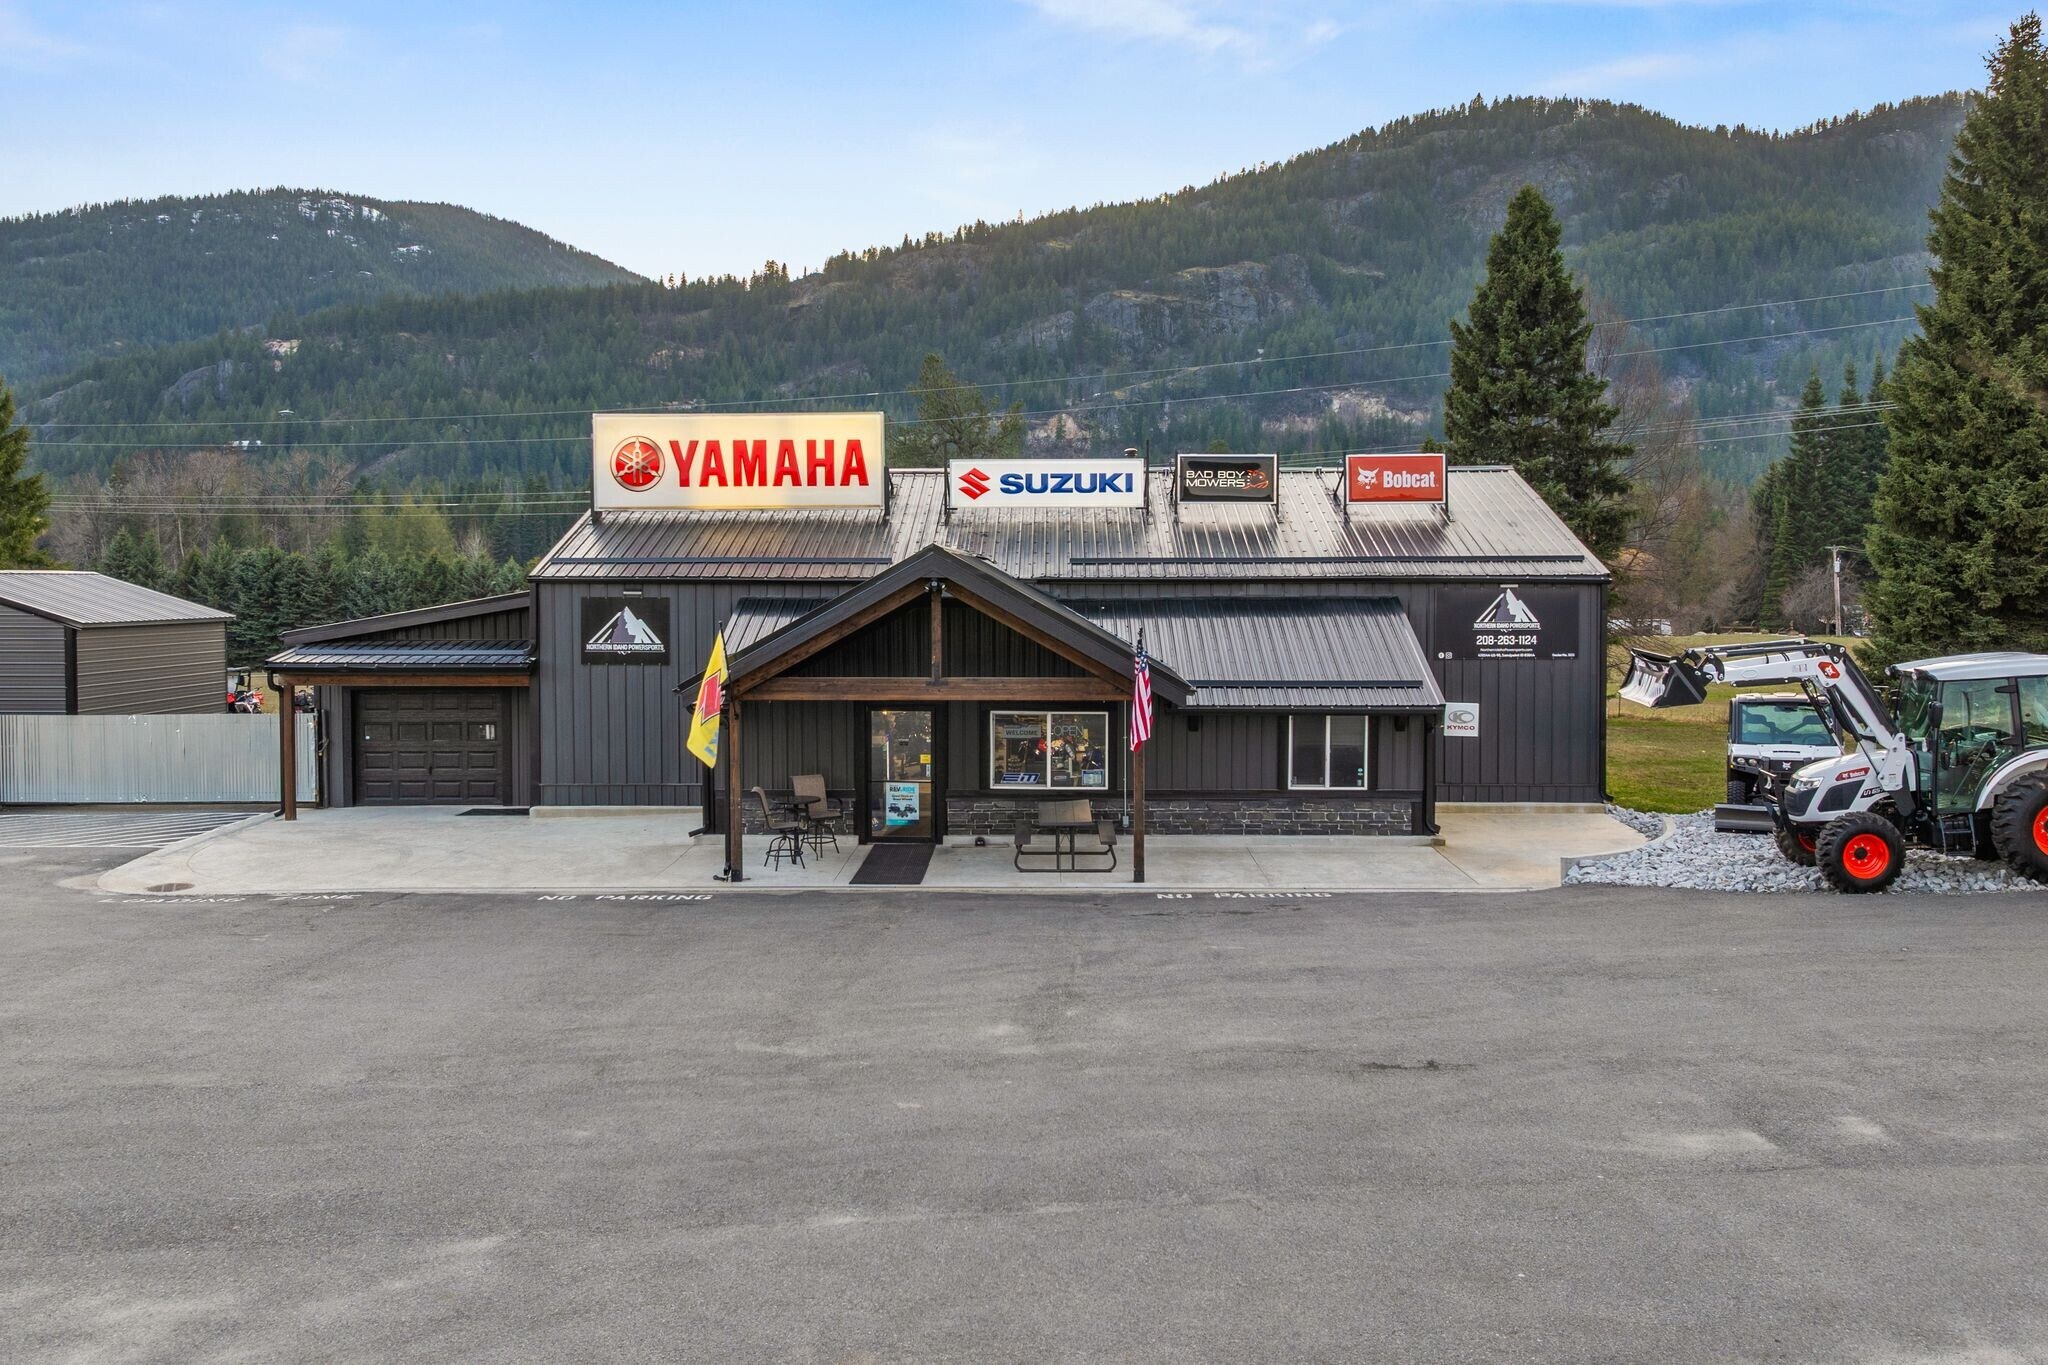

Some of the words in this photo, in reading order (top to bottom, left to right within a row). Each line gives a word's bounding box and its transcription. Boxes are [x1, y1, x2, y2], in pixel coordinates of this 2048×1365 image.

[669, 439, 869, 487] YAMAHA
[1186, 470, 1214, 479] BAD
[1217, 470, 1245, 479] BOY
[1383, 470, 1435, 488] Bobcat
[999, 473, 1133, 494] SUZUKI
[1186, 478, 1246, 487] MOWERS
[1476, 635, 1537, 645] 208-263-1124
[1053, 725, 1084, 736] OPEN
